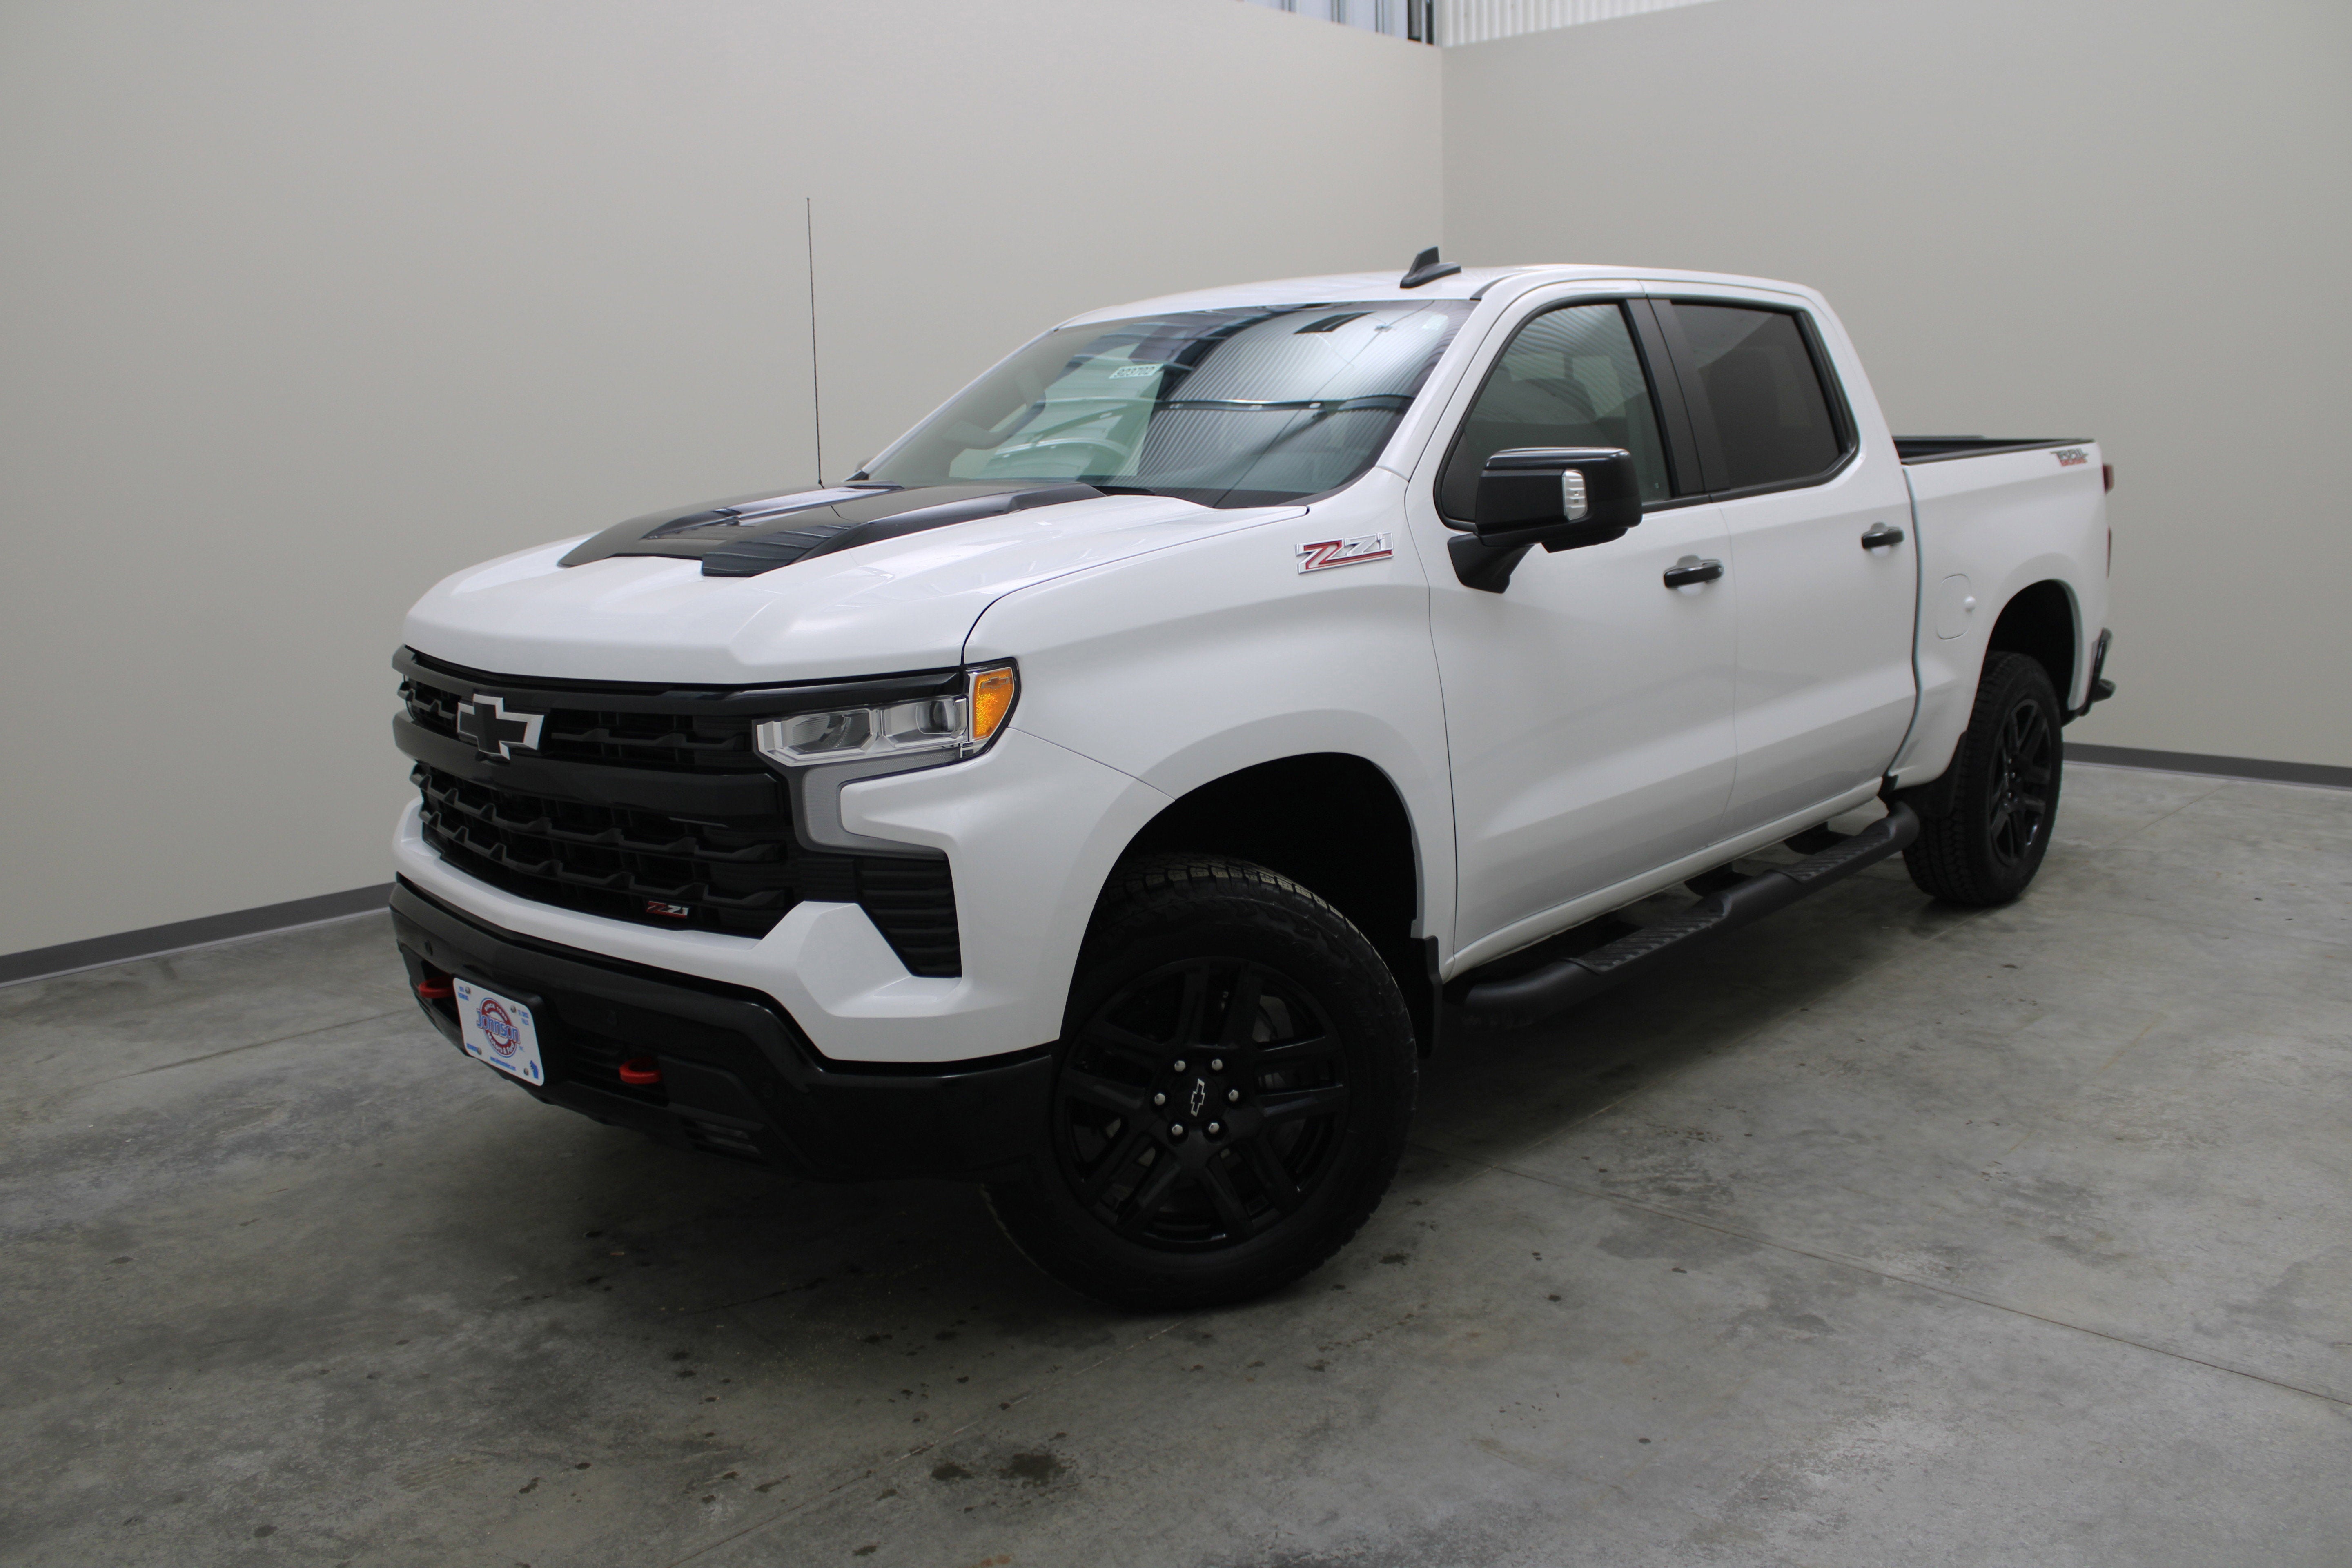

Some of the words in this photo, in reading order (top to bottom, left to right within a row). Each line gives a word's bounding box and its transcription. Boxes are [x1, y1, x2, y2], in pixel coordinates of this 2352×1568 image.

[1295, 532, 1394, 574] Z71
[646, 901, 689, 919] Z71
[477, 1008, 521, 1044] Johnson
